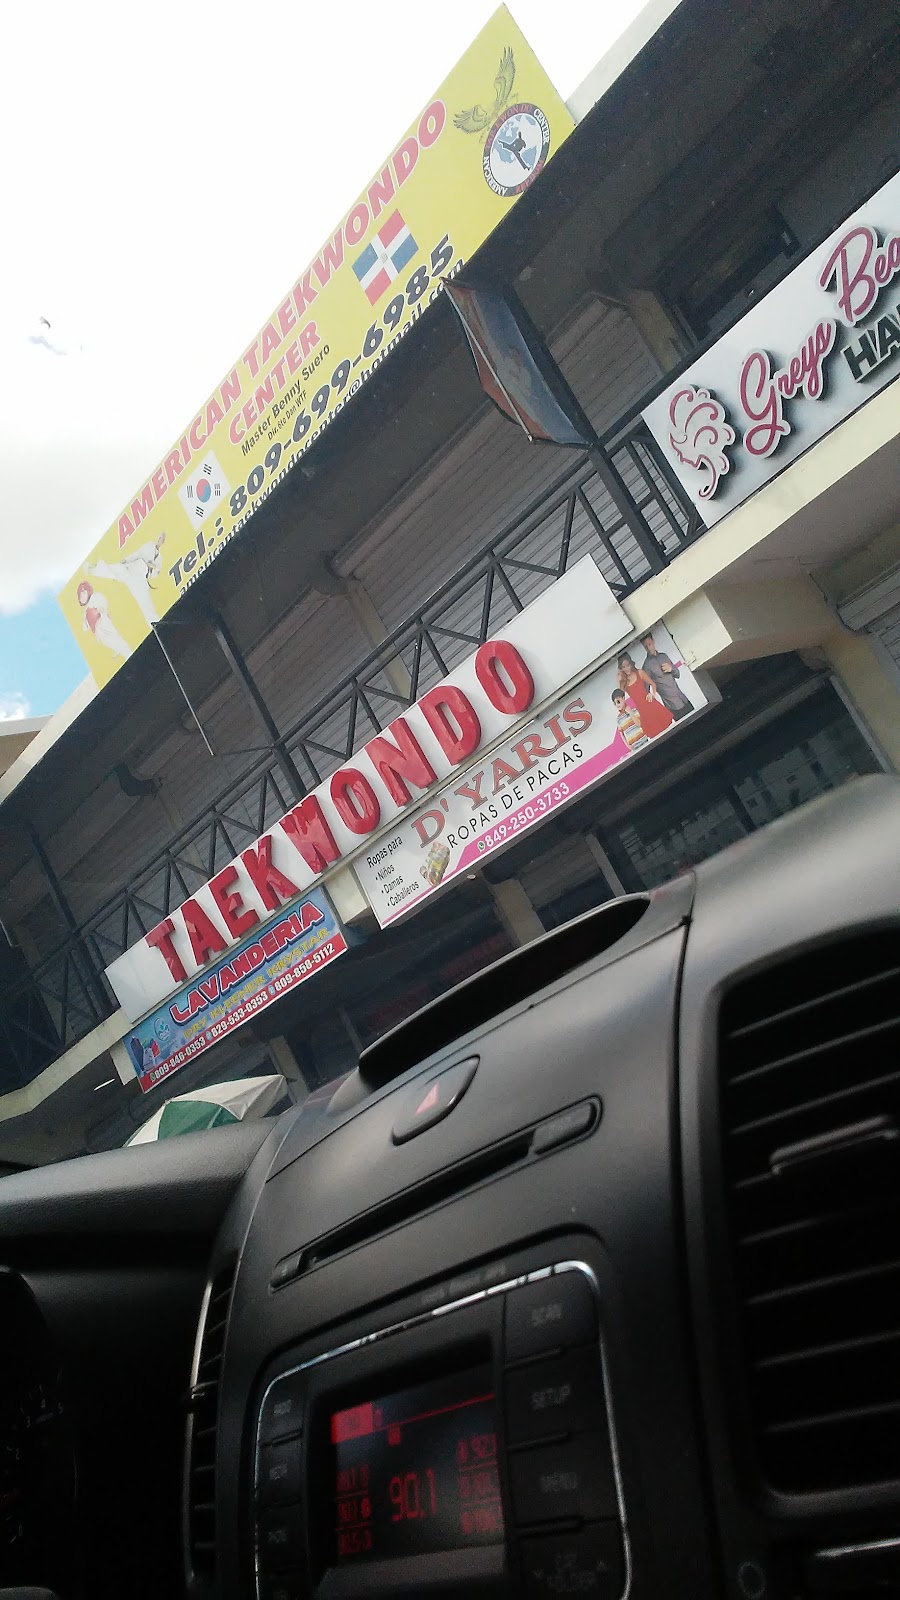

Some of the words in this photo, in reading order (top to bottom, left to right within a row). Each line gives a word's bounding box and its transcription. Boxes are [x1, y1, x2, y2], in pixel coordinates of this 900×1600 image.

[118, 369, 242, 548] AMERICAN
[242, 99, 446, 379] TAEKWONDO
[229, 233, 454, 518] 809-699-6985
[843, 304, 900, 381] HA
[228, 320, 321, 446] CENTER
[241, 415, 272, 457] Master
[271, 378, 302, 419] Benny
[301, 344, 330, 381] Suero
[286, 402, 297, 421] Dan
[295, 389, 308, 409] WTF
[739, 321, 832, 456] Greys
[144, 639, 535, 984] TAEKWONDO
[366, 846, 387, 869] Ropas
[386, 835, 403, 855] para
[447, 809, 499, 849] ROPAS
[499, 790, 525, 810] DE
[526, 743, 584, 792] PACAS
[484, 781, 571, 848] 849-250-3733
[169, 900, 325, 1025] LAVANDERIA
[184, 1018, 208, 1040] DRY
[209, 975, 267, 1021] KLEENER
[267, 927, 331, 978] KRYSTAR
[211, 991, 268, 1038] 829-533-0353
[274, 943, 336, 992] 809-858-5112
[388, 1468, 438, 1522] 90.1
